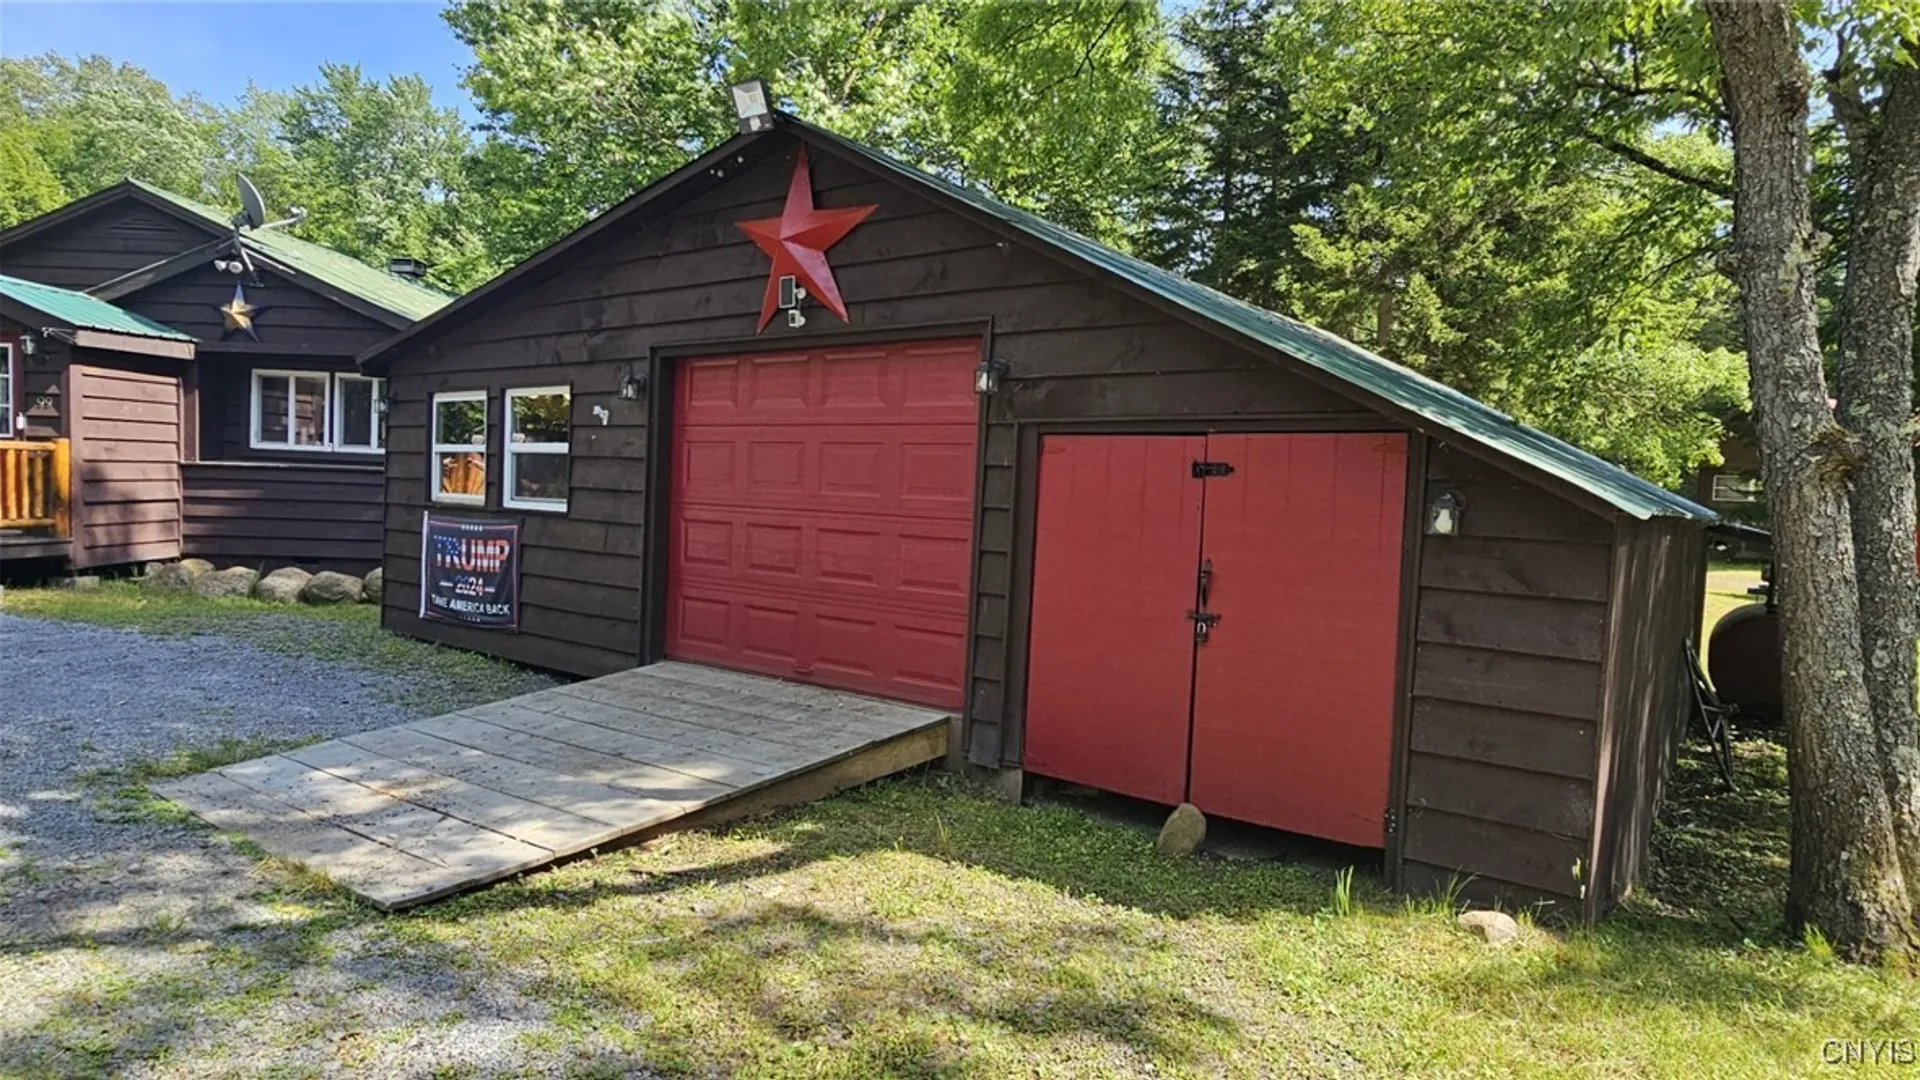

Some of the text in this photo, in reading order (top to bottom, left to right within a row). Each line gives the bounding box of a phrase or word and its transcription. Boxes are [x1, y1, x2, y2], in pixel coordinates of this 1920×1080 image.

[36, 396, 53, 408] 99
[433, 534, 510, 572] TRUMP
[455, 575, 483, 597] 2024
[431, 594, 511, 615] TAKE AMERICA BACK
